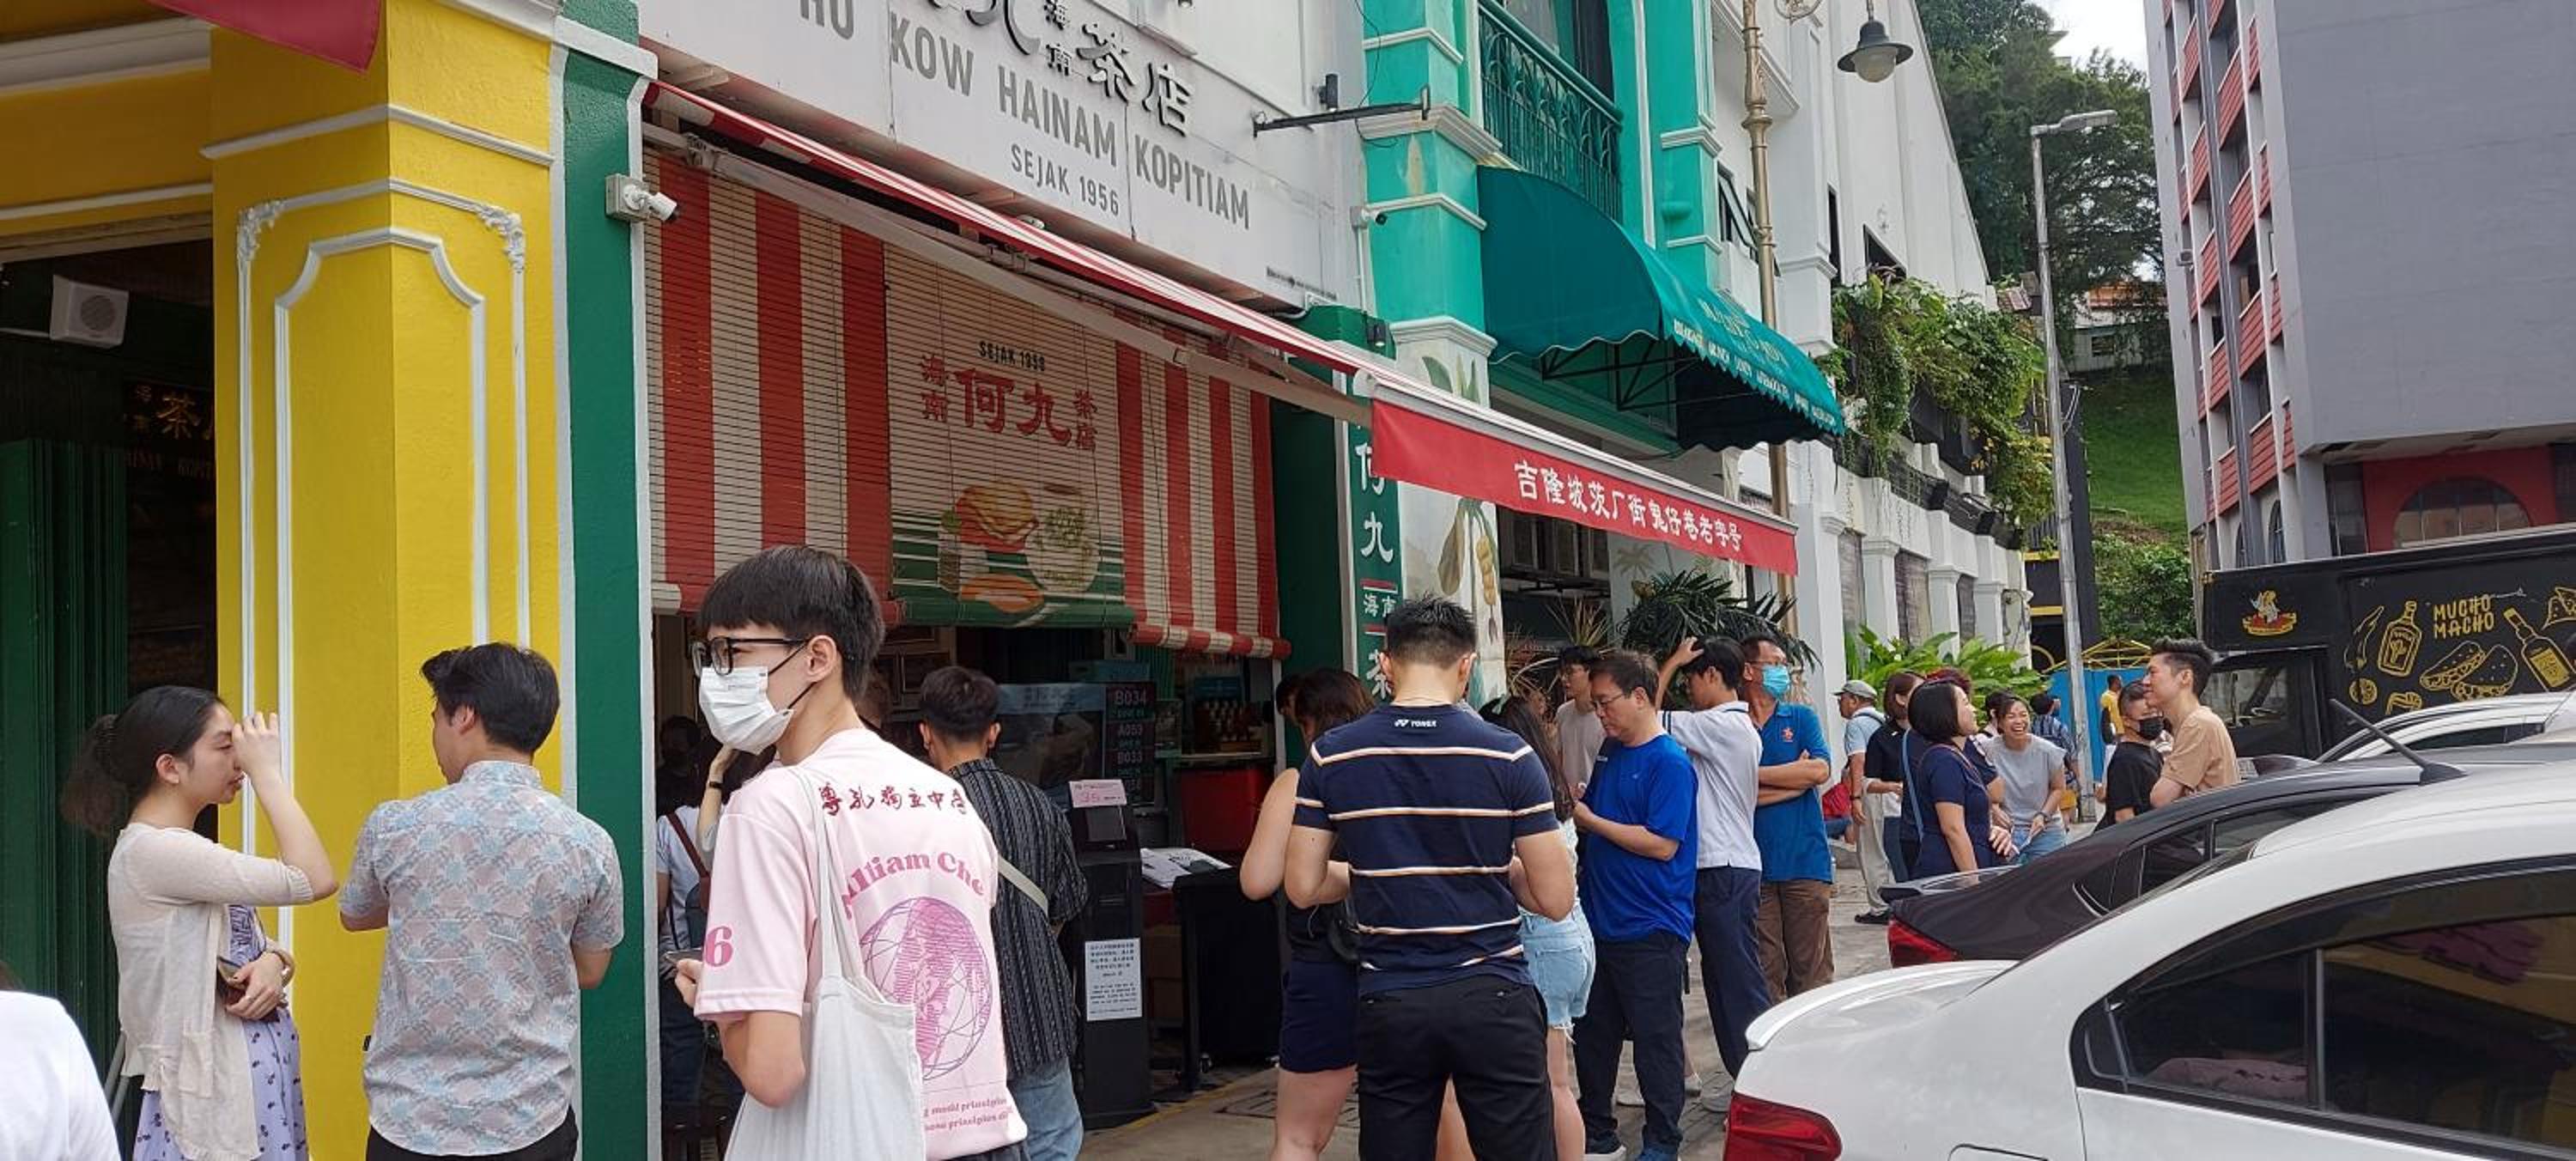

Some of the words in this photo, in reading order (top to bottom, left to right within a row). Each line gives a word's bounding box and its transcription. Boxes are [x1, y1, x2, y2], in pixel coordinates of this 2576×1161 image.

[1076, 21, 1193, 137] 茶店
[890, 10, 975, 96] KOW
[999, 64, 1116, 167] HAINAM
[1134, 133, 1250, 230] KOPITIAM
[1011, 143, 1071, 196] SEJAK
[1079, 175, 1120, 216] 1956
[979, 341, 1016, 366] SEJAK
[952, 367, 1072, 447] 何九
[2433, 593, 2492, 622] MUCHO
[2433, 611, 2495, 641] MACHO
[1411, 719, 1437, 728] YONEX
